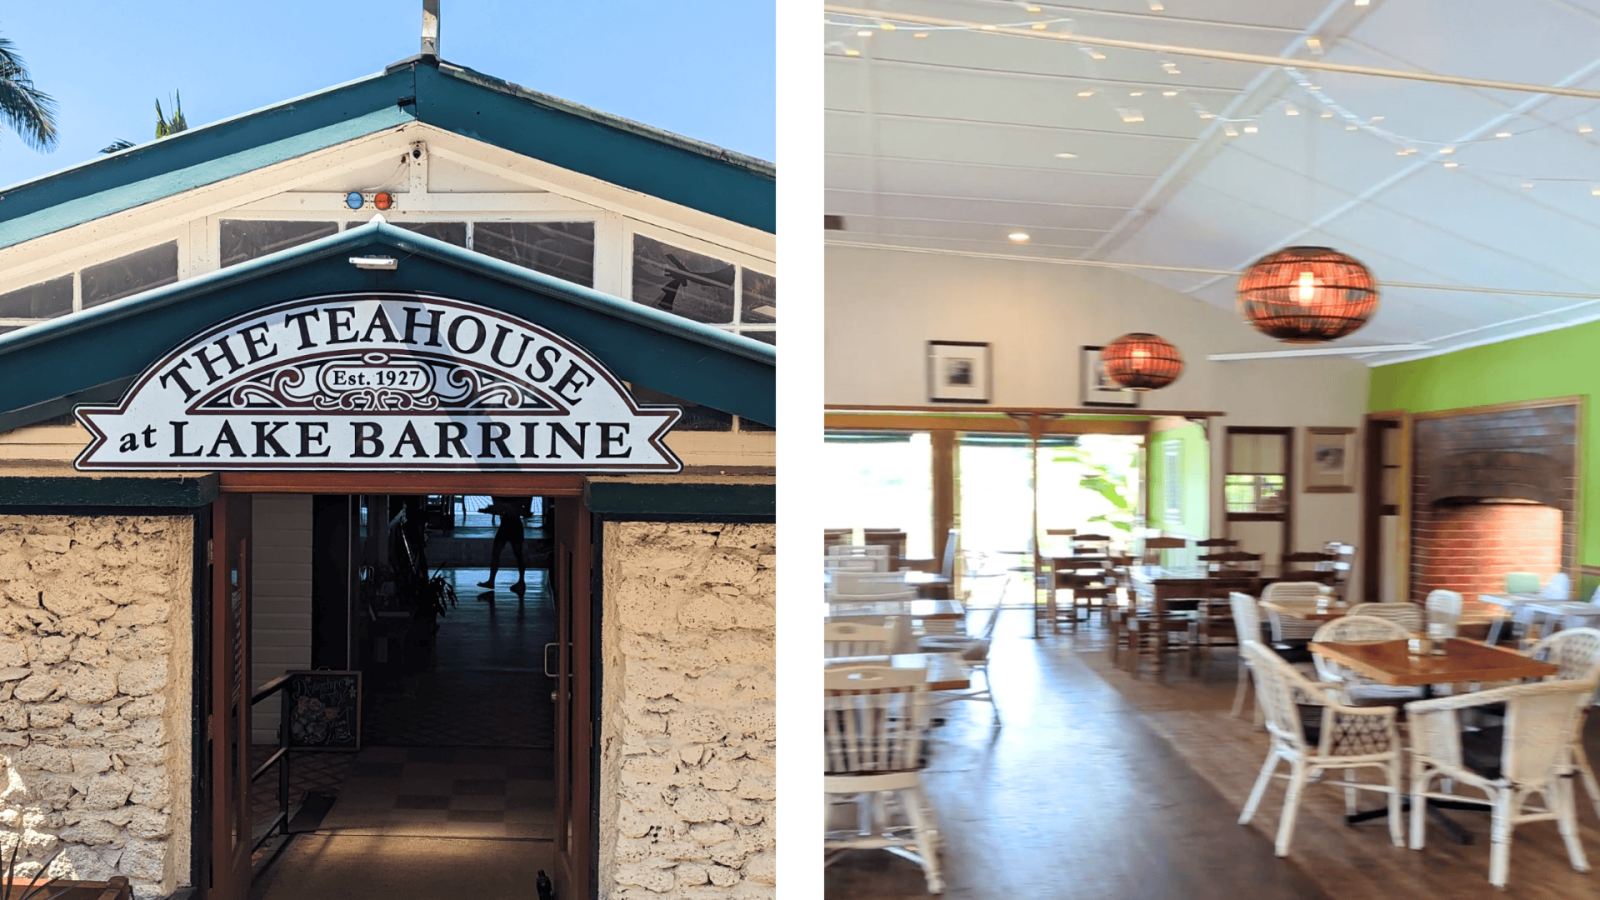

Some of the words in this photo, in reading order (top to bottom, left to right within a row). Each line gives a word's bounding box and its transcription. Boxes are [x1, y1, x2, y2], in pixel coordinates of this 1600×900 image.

[160, 322, 278, 404] THE
[285, 304, 596, 406] TEAHOUSE
[332, 370, 371, 386] Est.
[375, 370, 420, 387] 1927
[119, 425, 157, 453] at
[169, 421, 331, 458] LAKE
[350, 421, 632, 459] BARRINE
